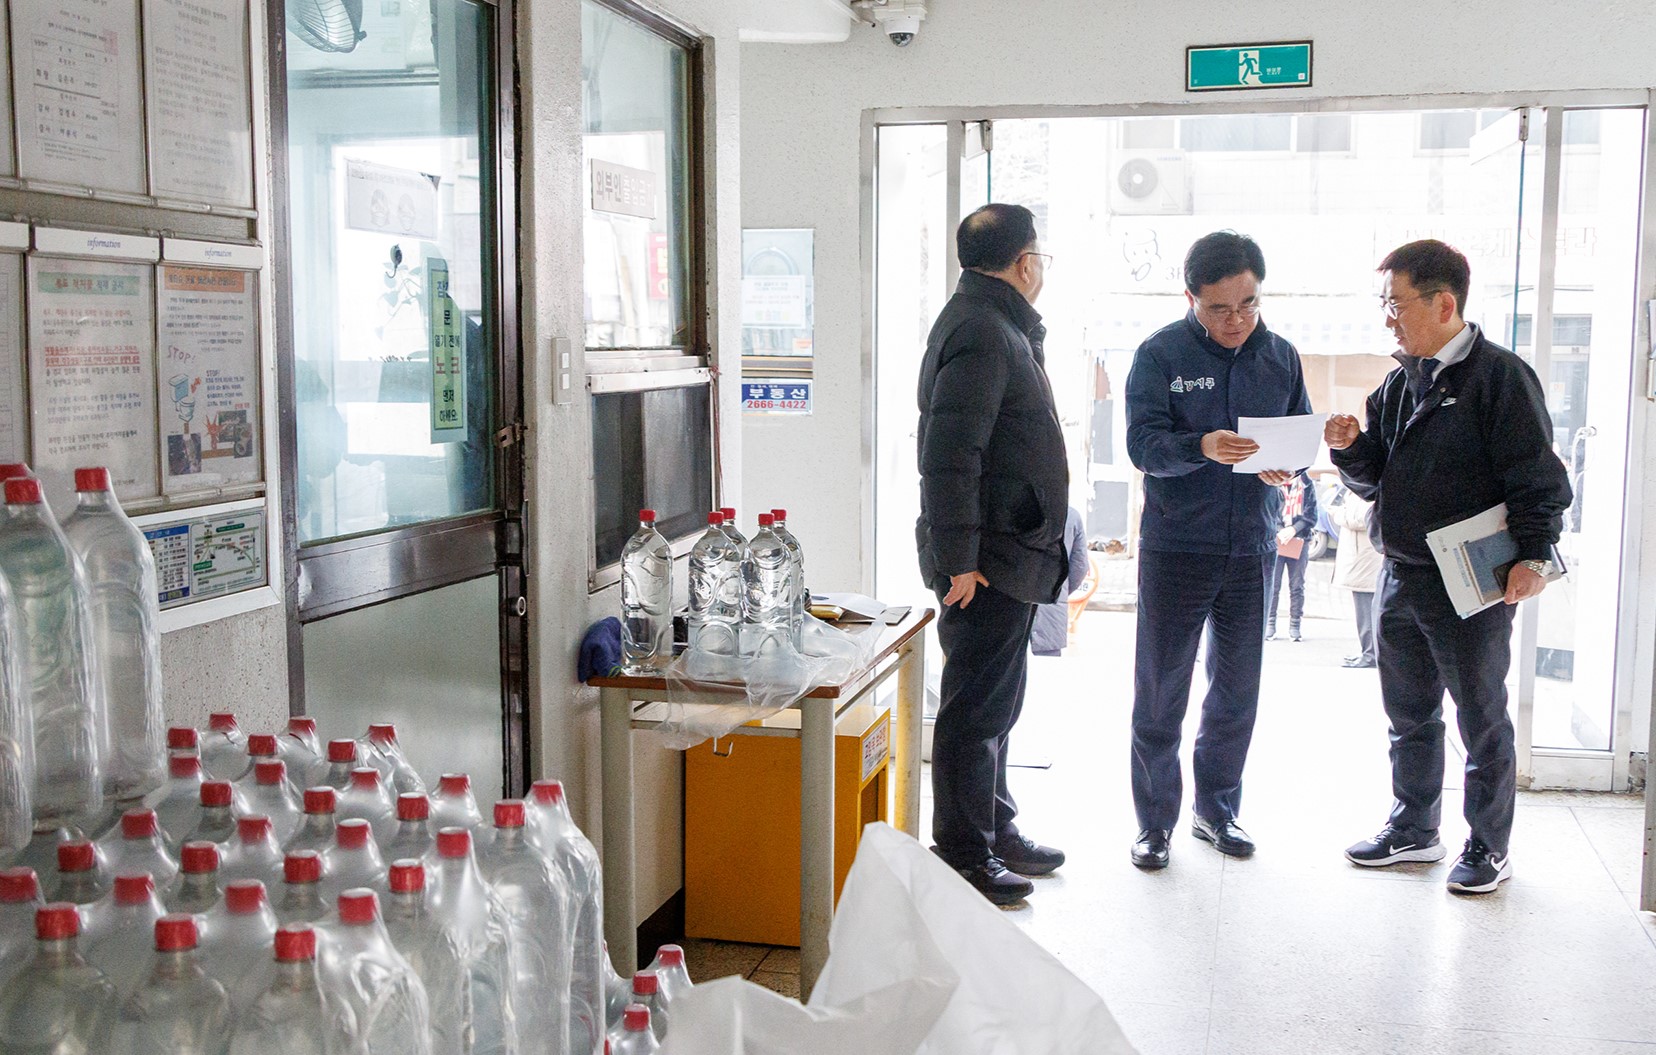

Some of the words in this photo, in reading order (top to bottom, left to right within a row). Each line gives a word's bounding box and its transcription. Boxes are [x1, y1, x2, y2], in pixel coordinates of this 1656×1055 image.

[596, 170, 622, 202] 외부인
[87, 238, 121, 250] information
[204, 249, 232, 259] information
[443, 309, 451, 326] 문
[167, 345, 196, 364] STOP!
[1184, 377, 1215, 392] 강서구
[442, 389, 455, 403] 먼저
[749, 388, 807, 399] 부동산
[747, 400, 807, 409] 2666-4422
[439, 408, 459, 422] 하세요
